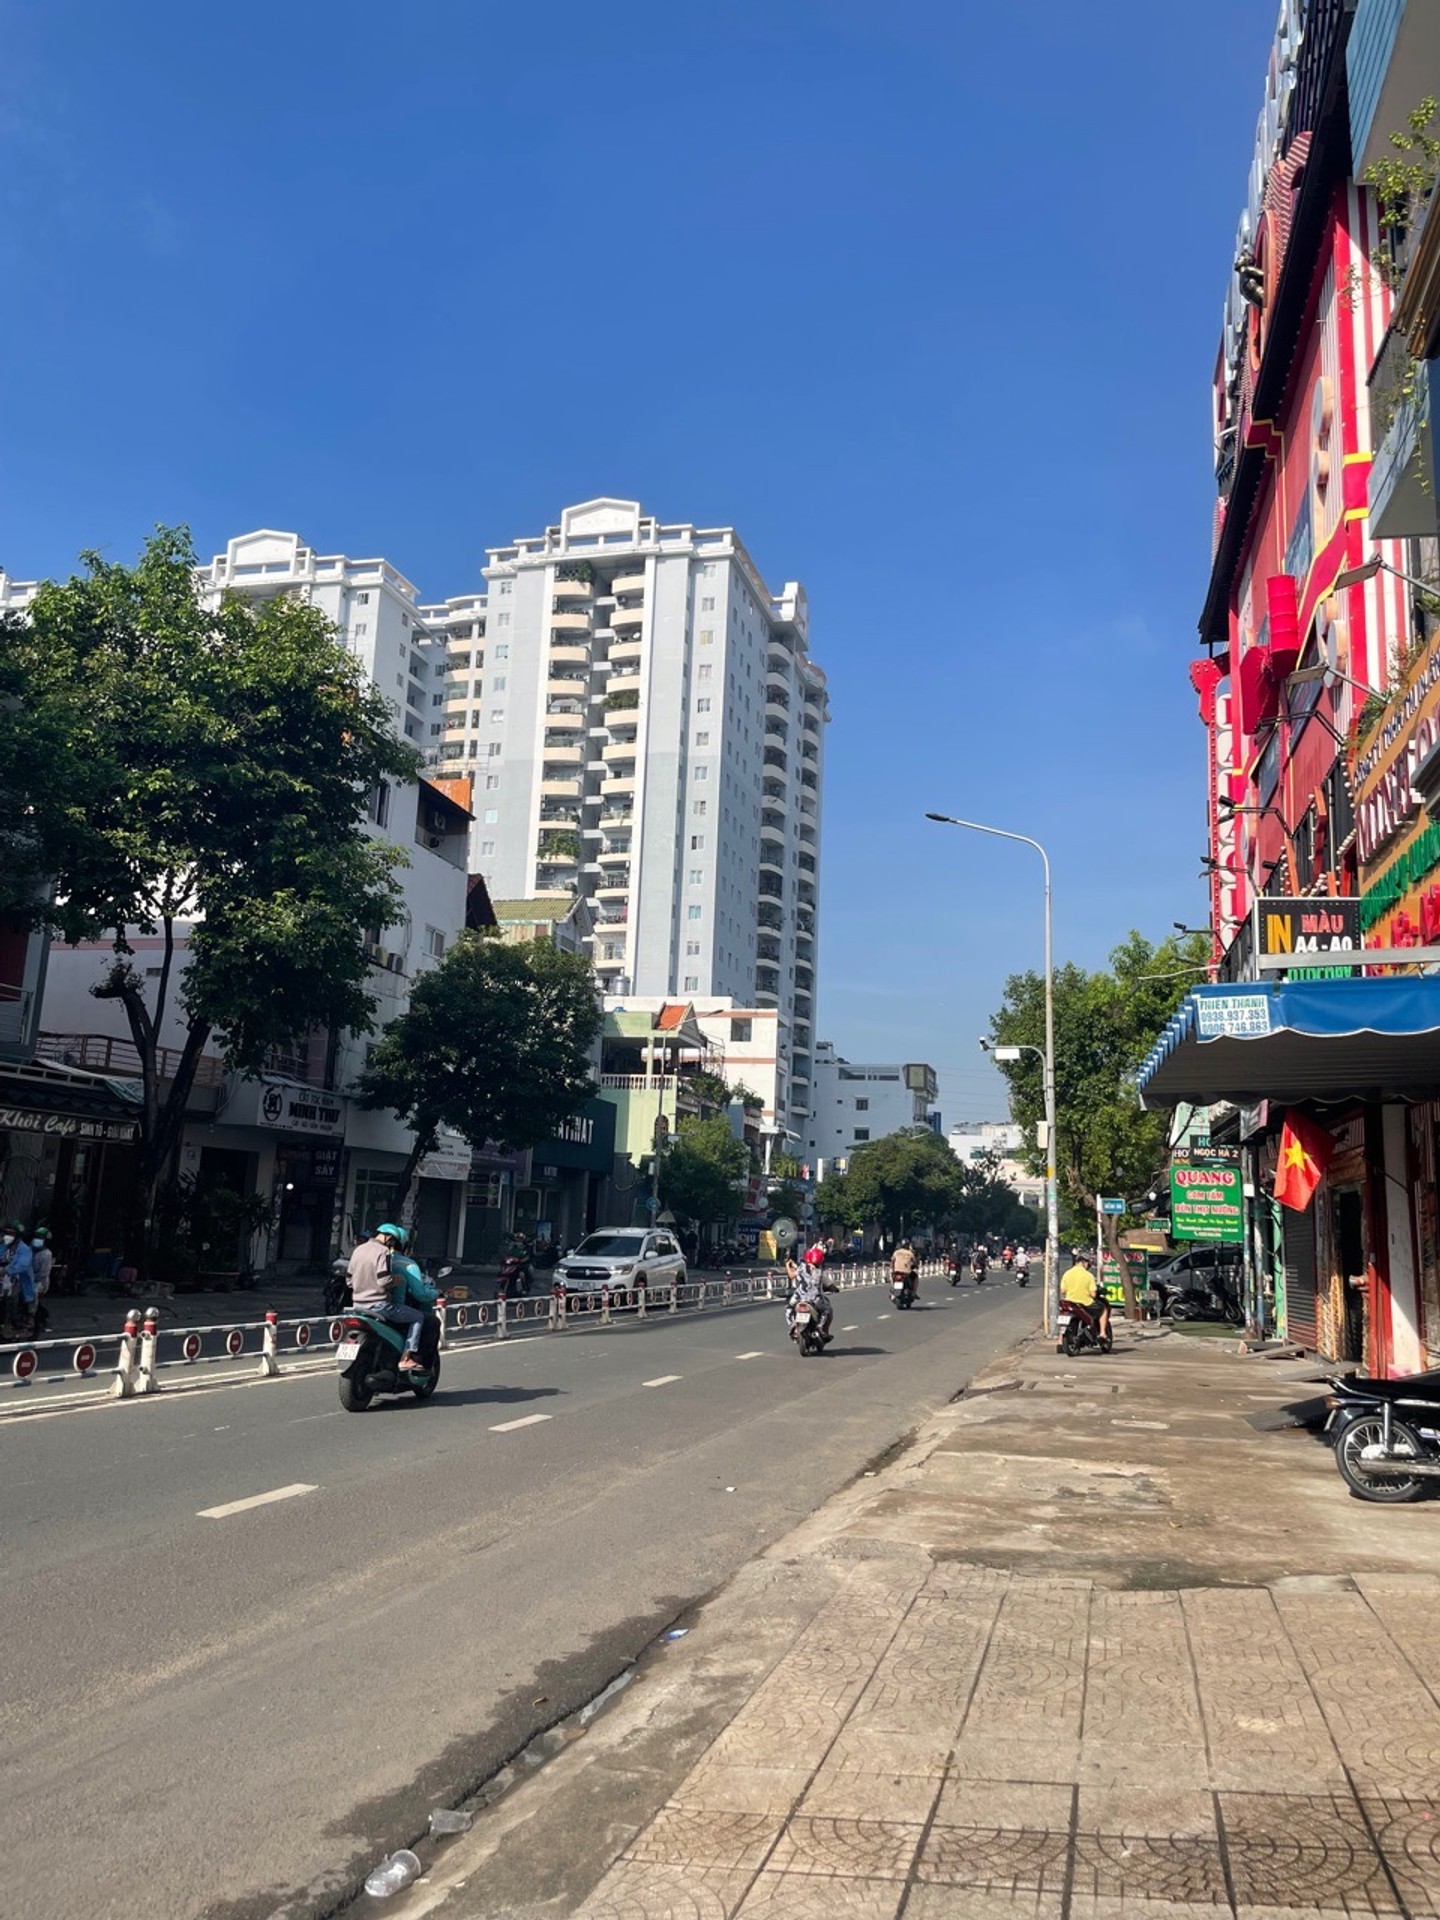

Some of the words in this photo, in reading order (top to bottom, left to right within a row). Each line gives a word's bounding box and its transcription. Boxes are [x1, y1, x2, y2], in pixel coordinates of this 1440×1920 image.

[1301, 909, 1344, 933] MÀU
[1267, 913, 1292, 954] IN
[1232, 1149, 1239, 1158] 2
[1175, 1169, 1236, 1187] QUANG
